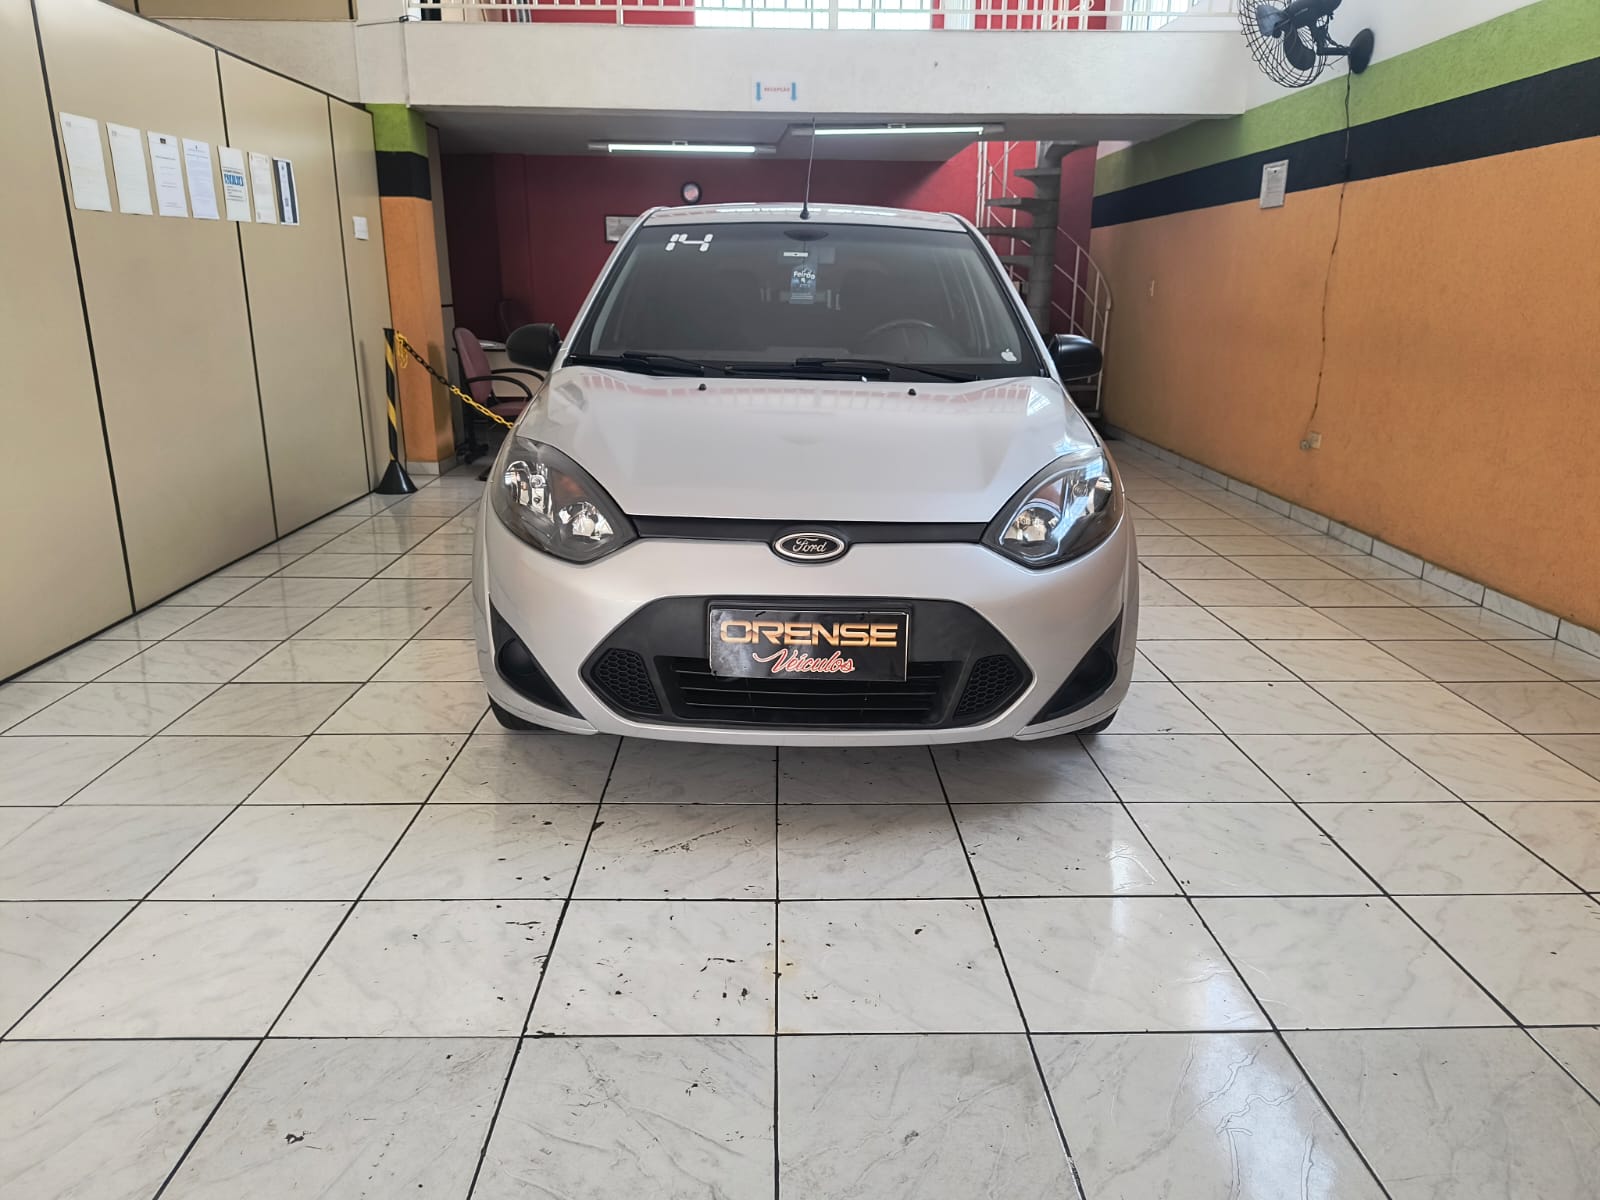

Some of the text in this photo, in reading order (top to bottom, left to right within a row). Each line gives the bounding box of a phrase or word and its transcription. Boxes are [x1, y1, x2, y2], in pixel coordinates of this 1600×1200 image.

[665, 234, 713, 252] 14
[792, 538, 827, 552] Ford
[720, 620, 898, 647] ORENSE
